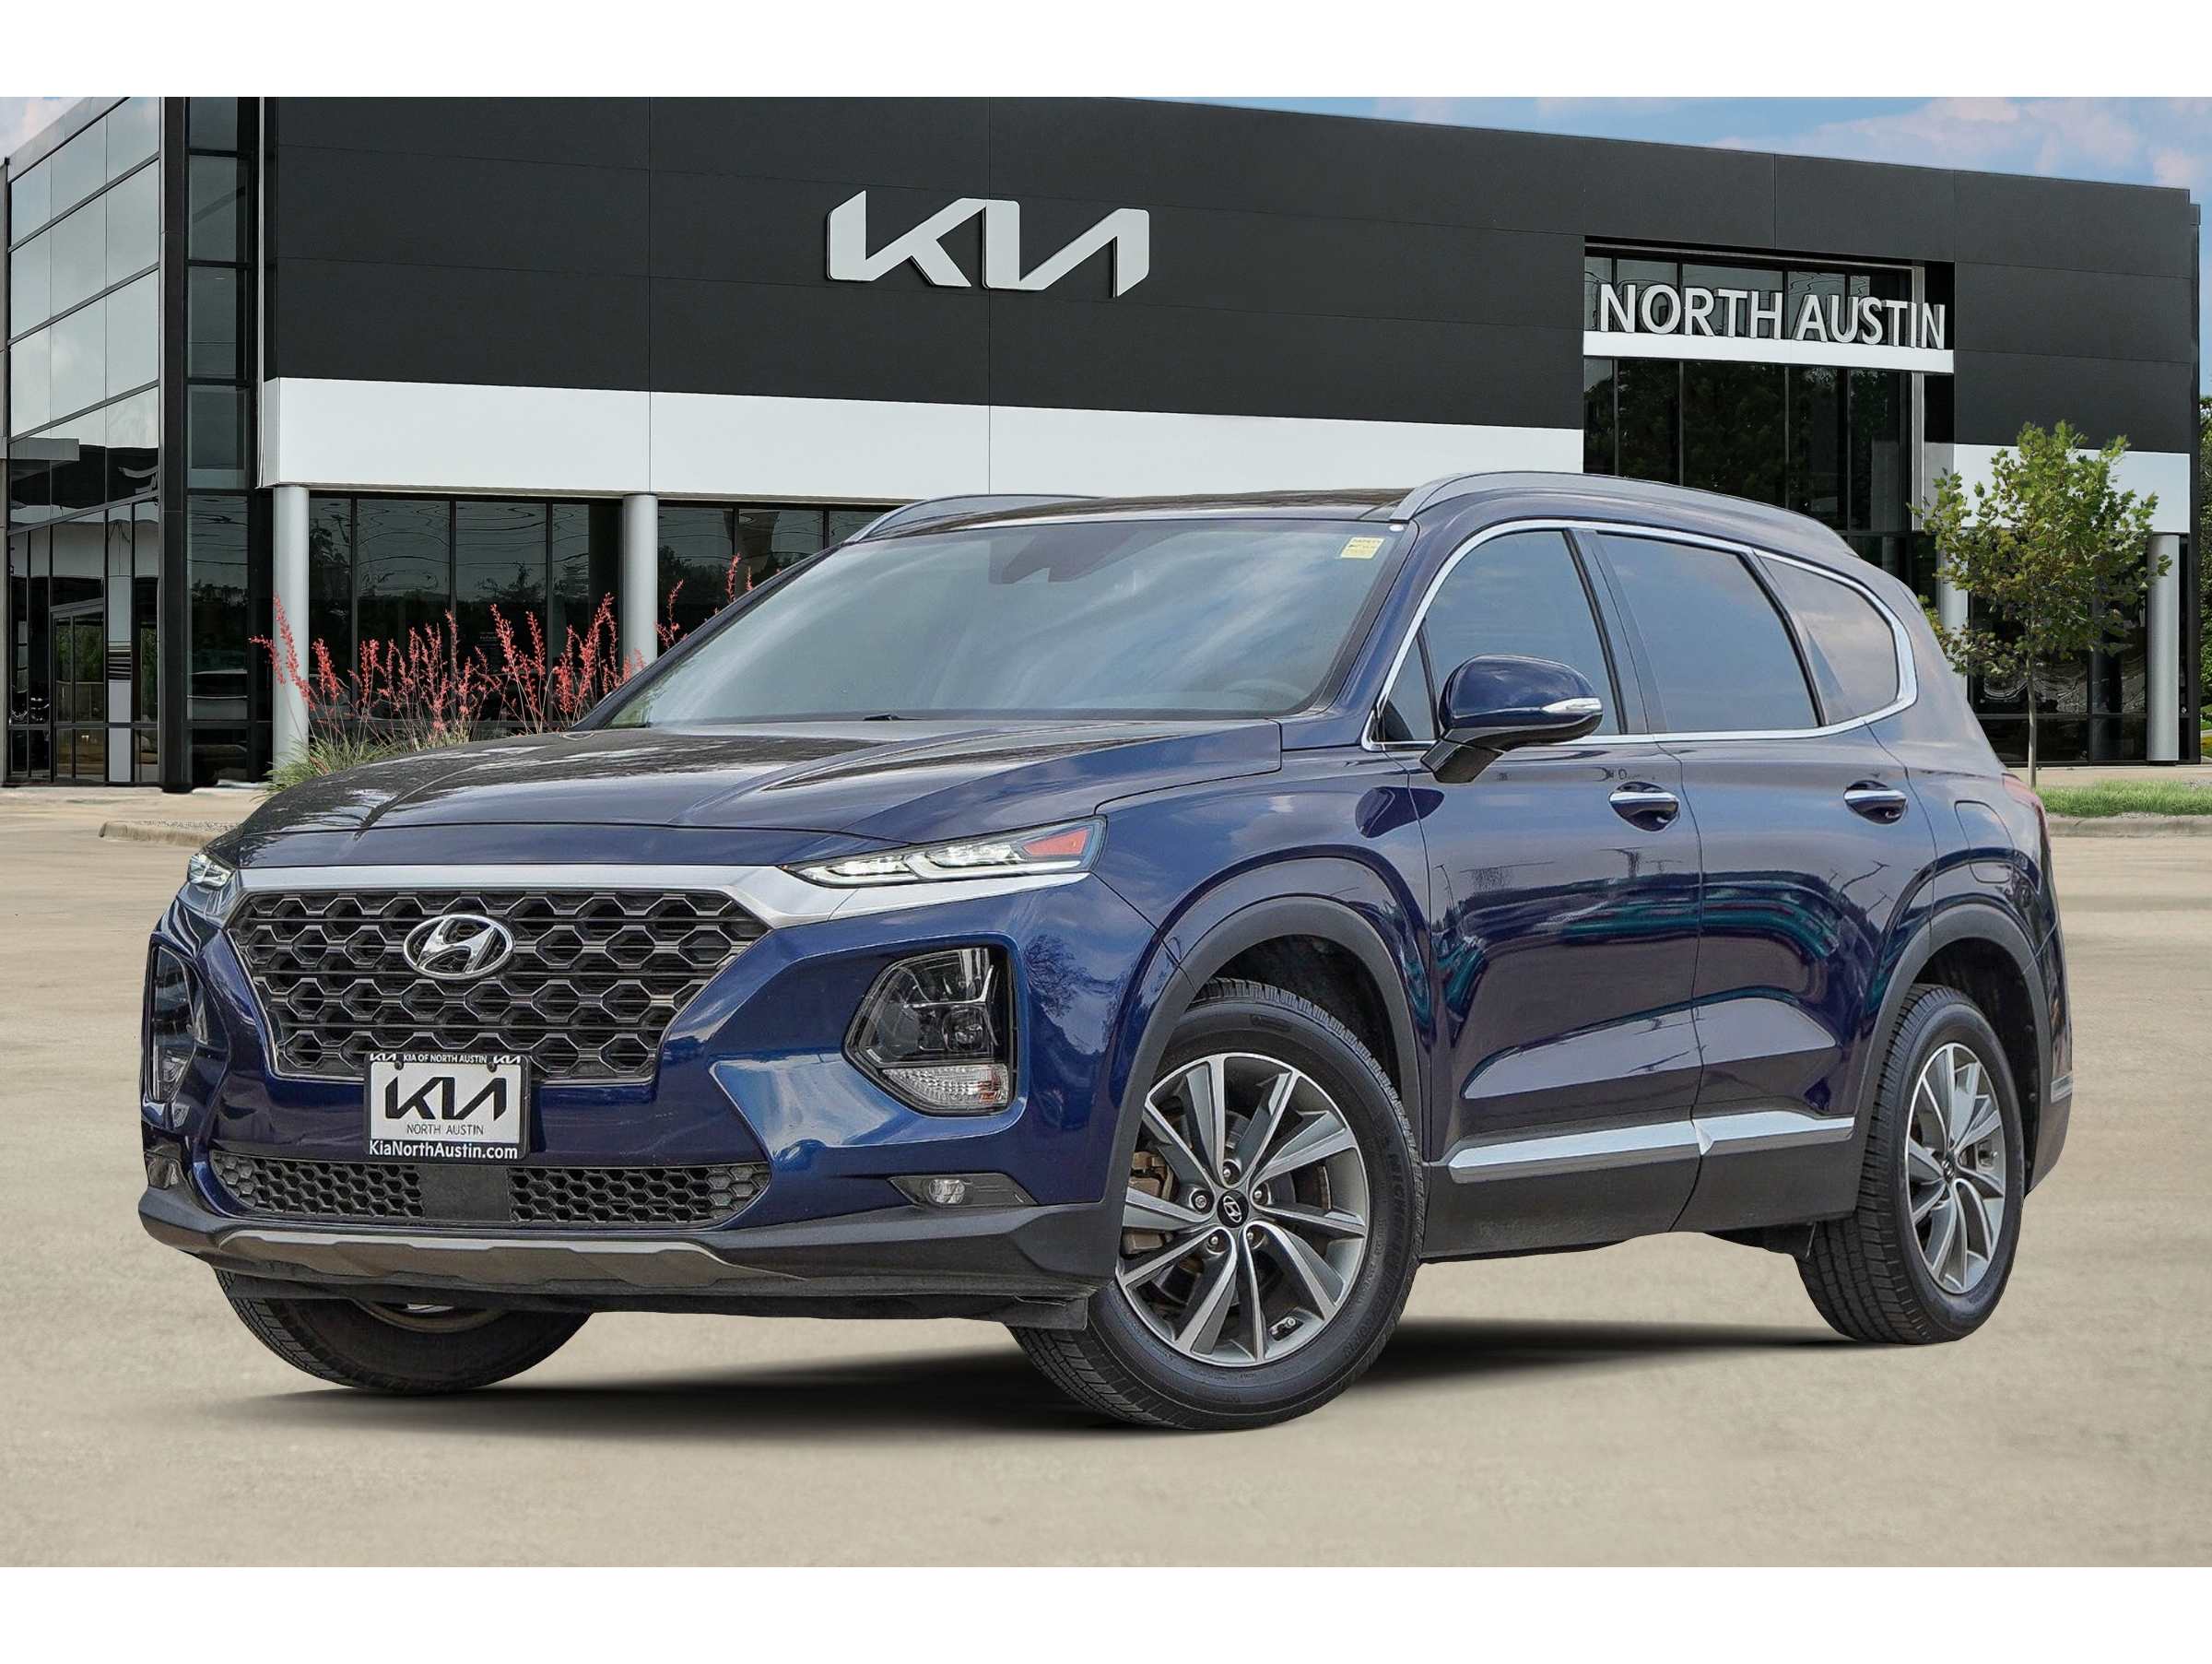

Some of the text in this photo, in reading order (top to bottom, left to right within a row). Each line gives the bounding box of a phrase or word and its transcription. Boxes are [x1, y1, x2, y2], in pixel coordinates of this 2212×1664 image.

[827, 190, 1149, 298] KIA
[1599, 283, 1946, 349] NORTH AUSTIN
[403, 1054, 488, 1063] KIA OF NORTH AUSTIN
[385, 1076, 507, 1121] KIA
[406, 1124, 484, 1135] NORTH AUSTIN
[370, 1140, 518, 1159] KiaNorthAustin.com
